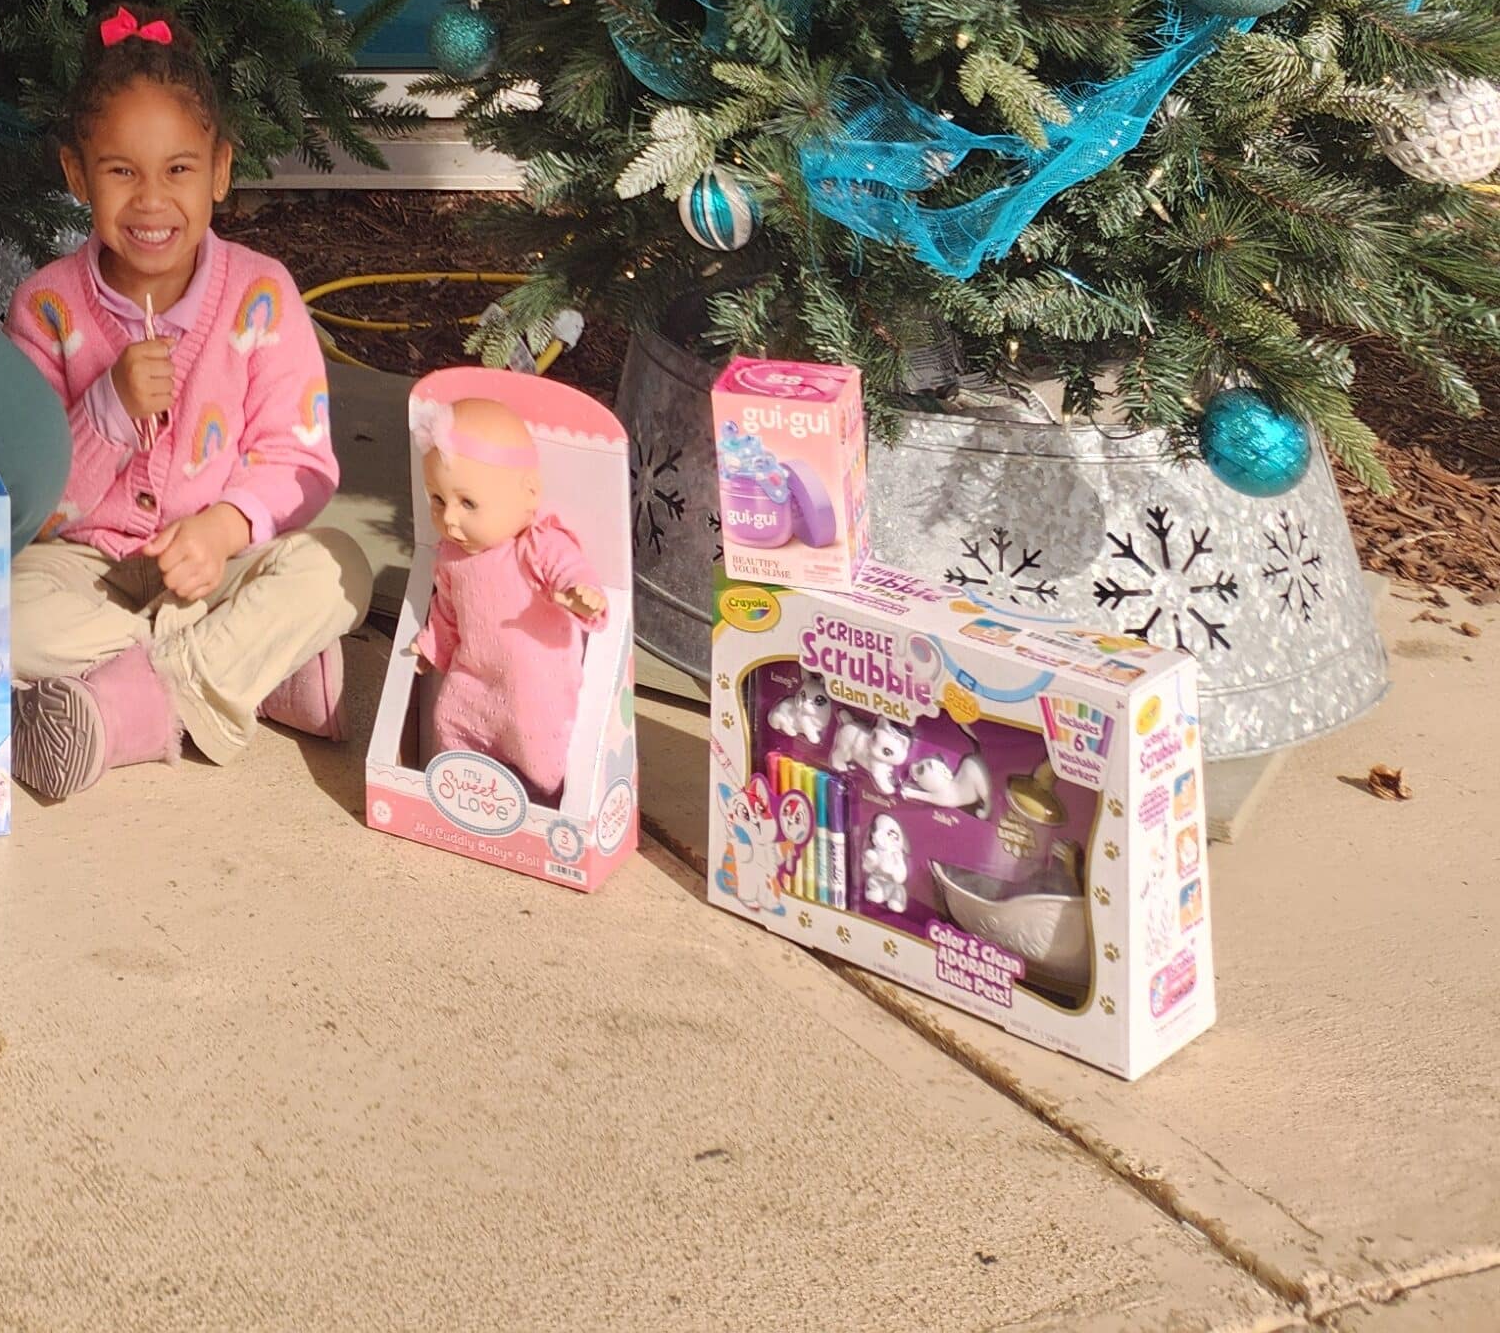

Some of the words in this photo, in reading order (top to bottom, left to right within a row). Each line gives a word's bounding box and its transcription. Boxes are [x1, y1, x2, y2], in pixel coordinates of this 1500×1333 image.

[732, 555, 781, 569] BEAUTIFY
[732, 564, 759, 575] YOUR
[761, 568, 792, 579] SLIME
[862, 564, 925, 584] RIBBLE
[861, 573, 943, 602] ubbie
[871, 587, 908, 602] Pack
[728, 597, 770, 611] Crayola
[815, 616, 893, 657] SCRIBBLE
[802, 632, 932, 706] Scrubbie
[829, 679, 869, 707] Glam
[873, 694, 910, 721] Pack
[1074, 734, 1085, 752] 6
[439, 770, 516, 807] Sweet
[413, 822, 432, 840] My
[435, 827, 475, 852] Cuddly
[516, 852, 541, 868] Doll
[929, 924, 967, 952] Color
[981, 945, 1021, 975] Clean
[938, 945, 1012, 989] ADORABLE
[938, 962, 973, 991] Little
